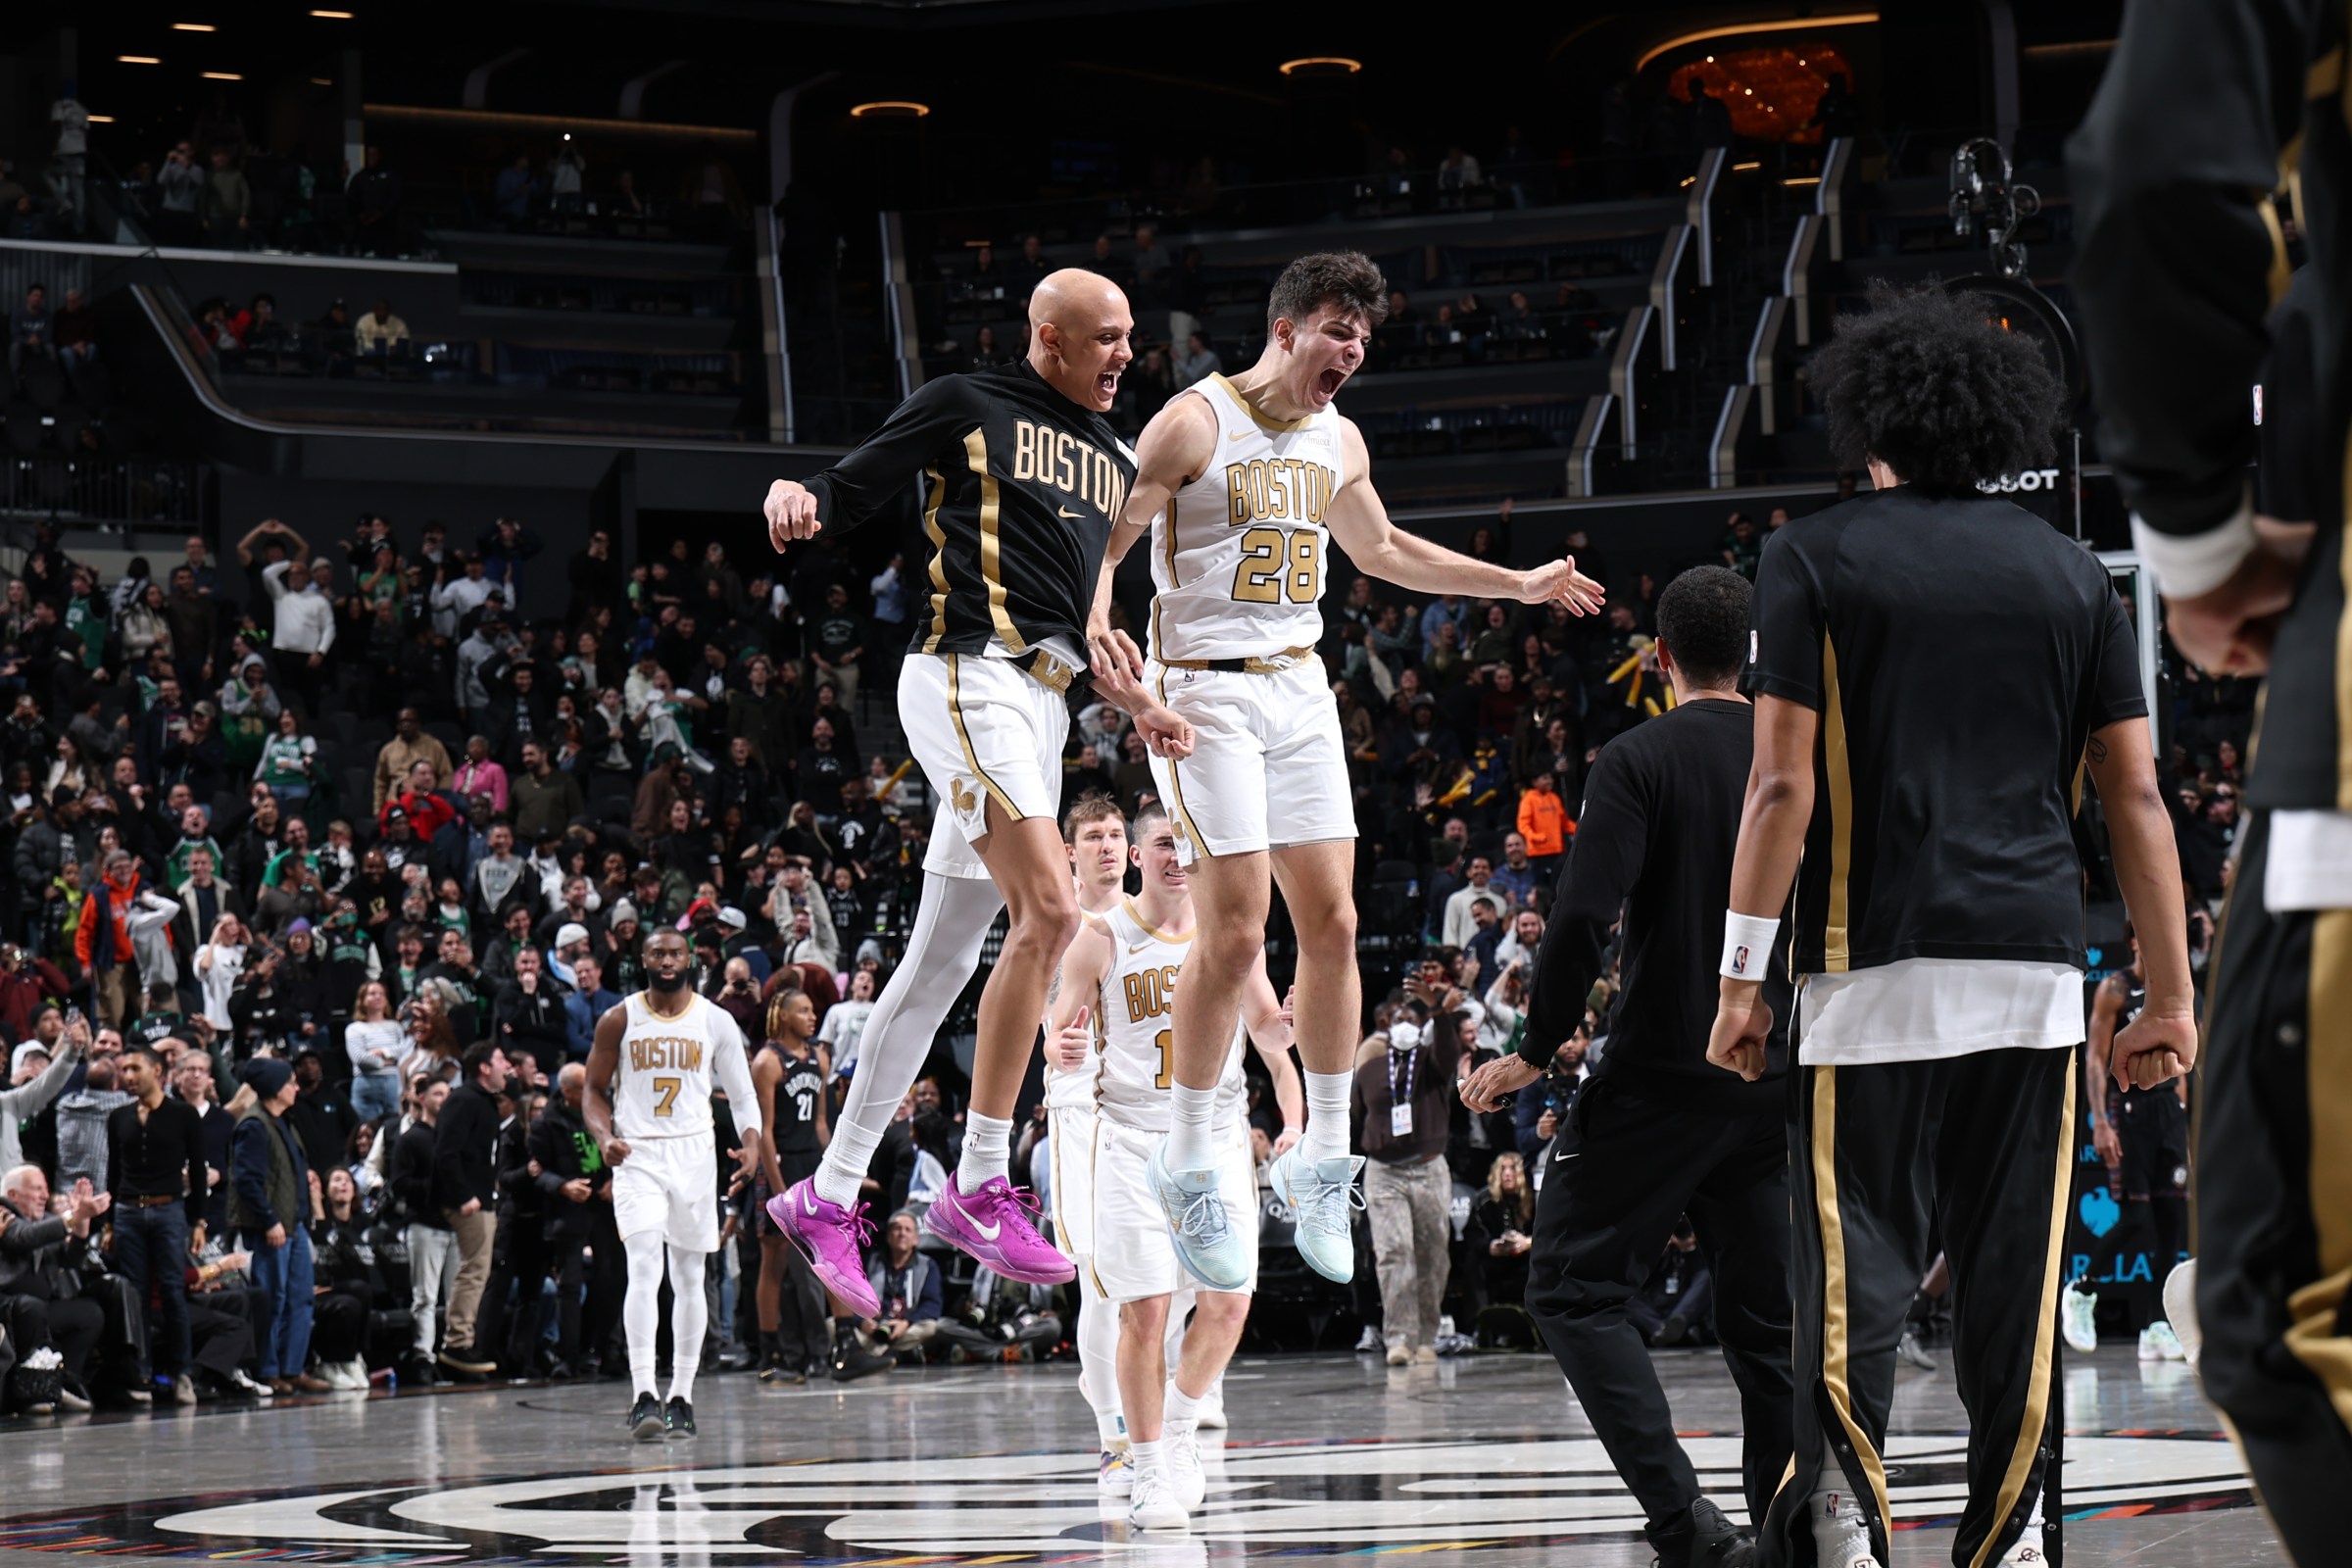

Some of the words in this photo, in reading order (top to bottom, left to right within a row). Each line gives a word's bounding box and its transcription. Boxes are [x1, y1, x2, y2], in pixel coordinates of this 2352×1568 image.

[1012, 417, 1126, 532] BOSTON
[1226, 458, 1336, 527] BOSTON
[1231, 527, 1319, 605] 28
[1123, 964, 1182, 1023] BOS
[628, 1038, 704, 1073] BOSTON
[654, 1077, 682, 1117] 7
[797, 1093, 813, 1121] 21
